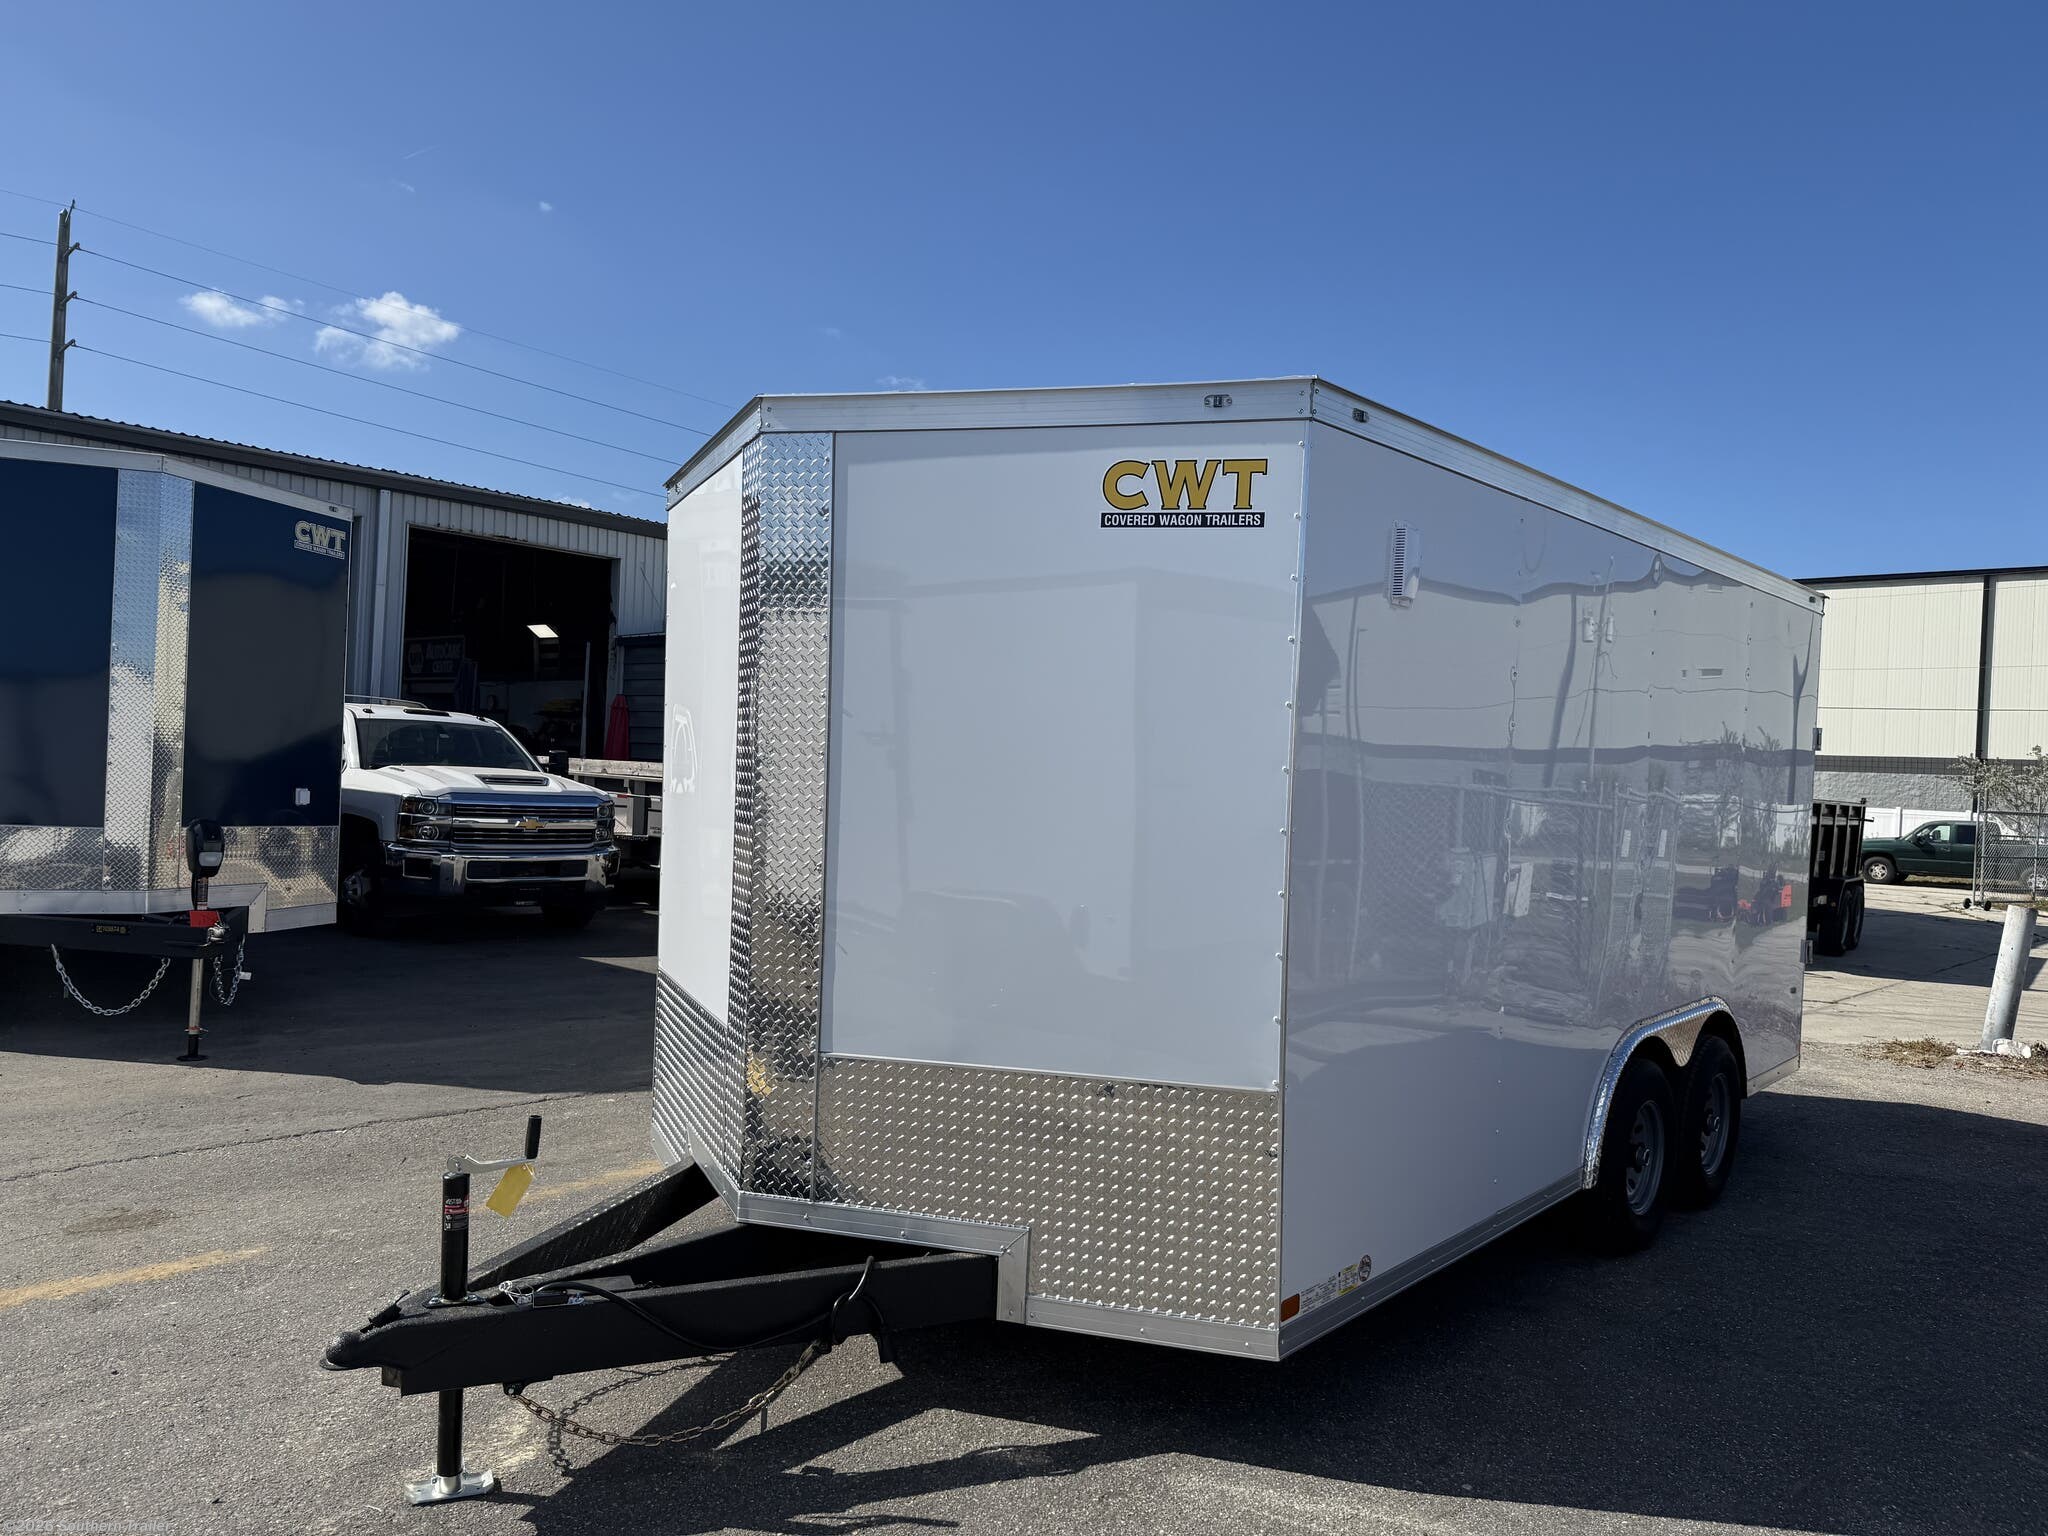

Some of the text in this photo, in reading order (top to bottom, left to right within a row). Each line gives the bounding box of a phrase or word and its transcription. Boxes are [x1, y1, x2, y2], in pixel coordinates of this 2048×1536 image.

[1102, 458, 1268, 511] CWT
[295, 520, 346, 550] CWT
[1104, 514, 1261, 526] COVERED WAGON TRAILERS
